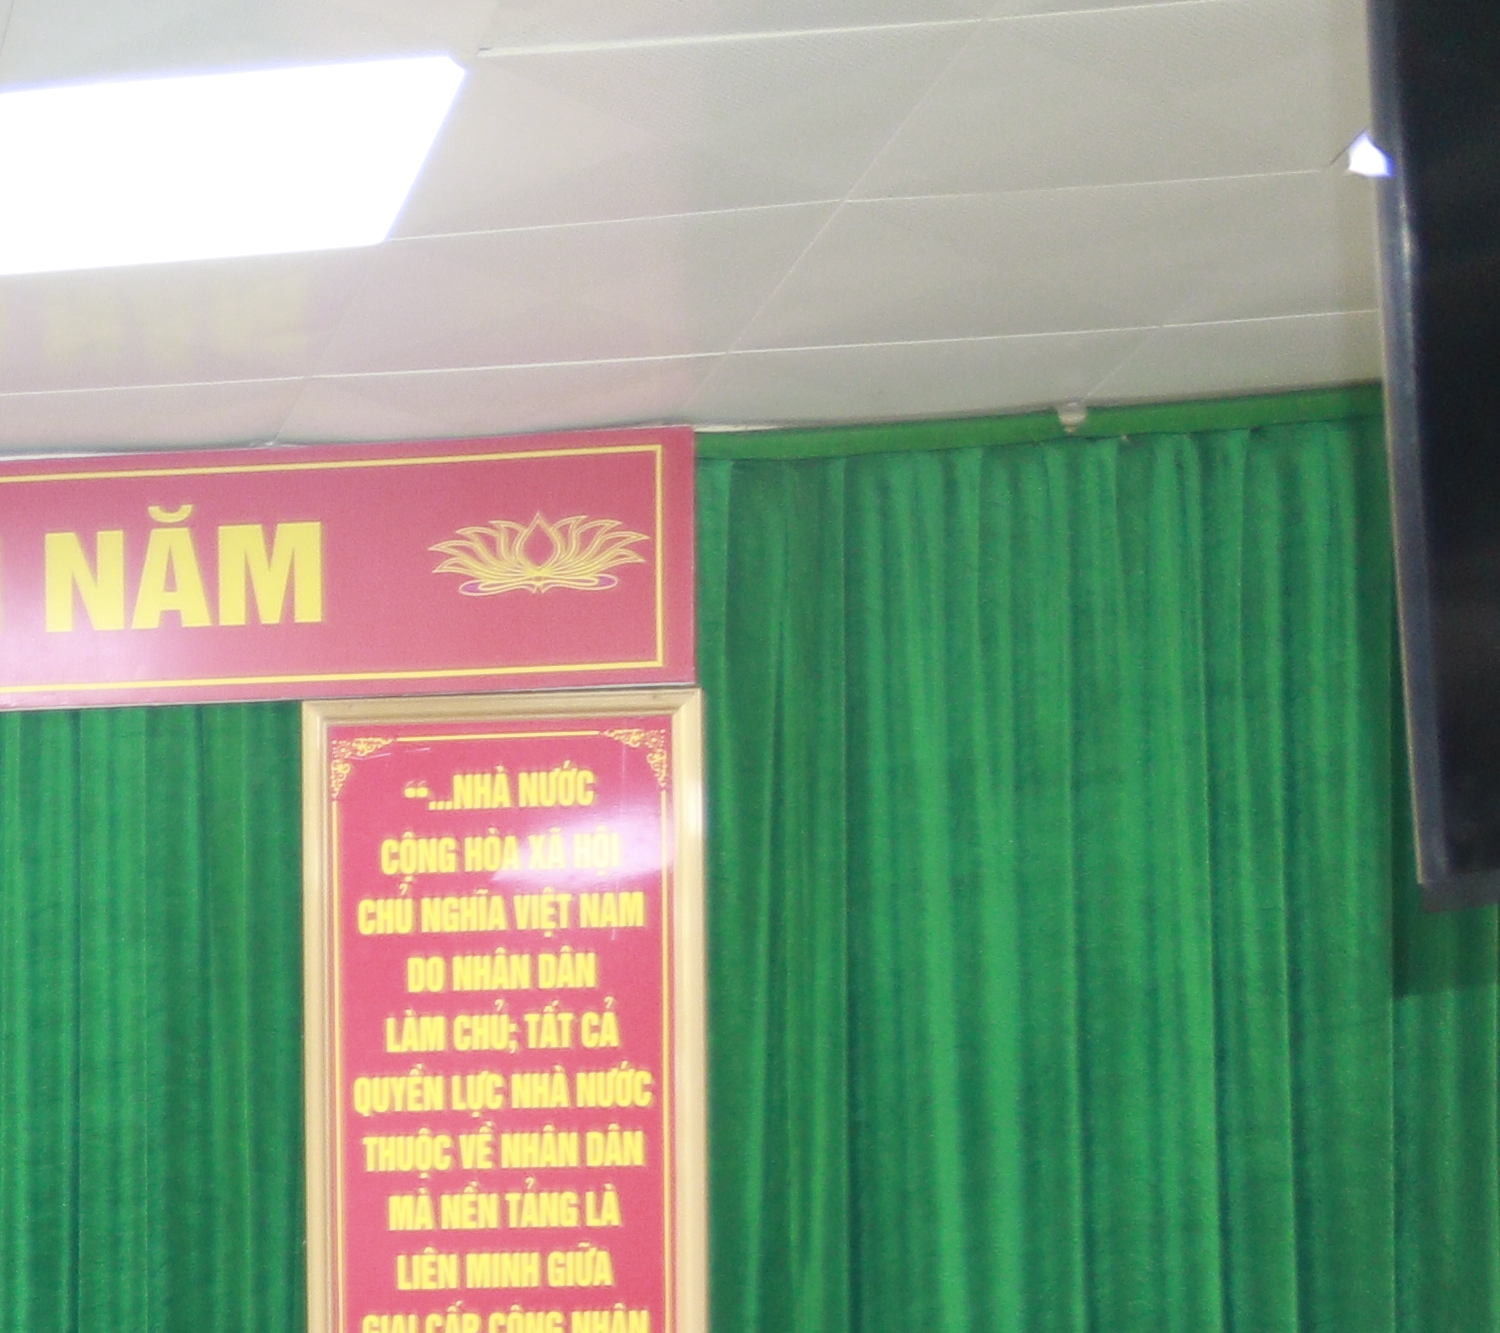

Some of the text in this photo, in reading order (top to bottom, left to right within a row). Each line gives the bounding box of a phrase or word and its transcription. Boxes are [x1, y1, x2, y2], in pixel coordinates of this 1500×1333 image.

[45, 504, 325, 632] NĂM
[518, 761, 596, 807] NƯỚC
[380, 831, 459, 882] CỘNG
[464, 828, 520, 872] HÒA
[528, 828, 566, 870] XÃ
[357, 882, 647, 937] CHỦ NGHĨA VIỆT NAM
[406, 946, 598, 993] DO NHÂN DÂN
[385, 996, 621, 1053] LÀM CHỦ; TẤT CẢ
[352, 1061, 654, 1117] QUYỀN LỰC NHÀ NƯỚC
[362, 1120, 646, 1178] THUỘC VỀ NHÂN DÂN
[387, 1176, 622, 1231] MÀ NỀN TẢNG LÀ
[396, 1242, 615, 1291] LIÊN MINH GIỮA
